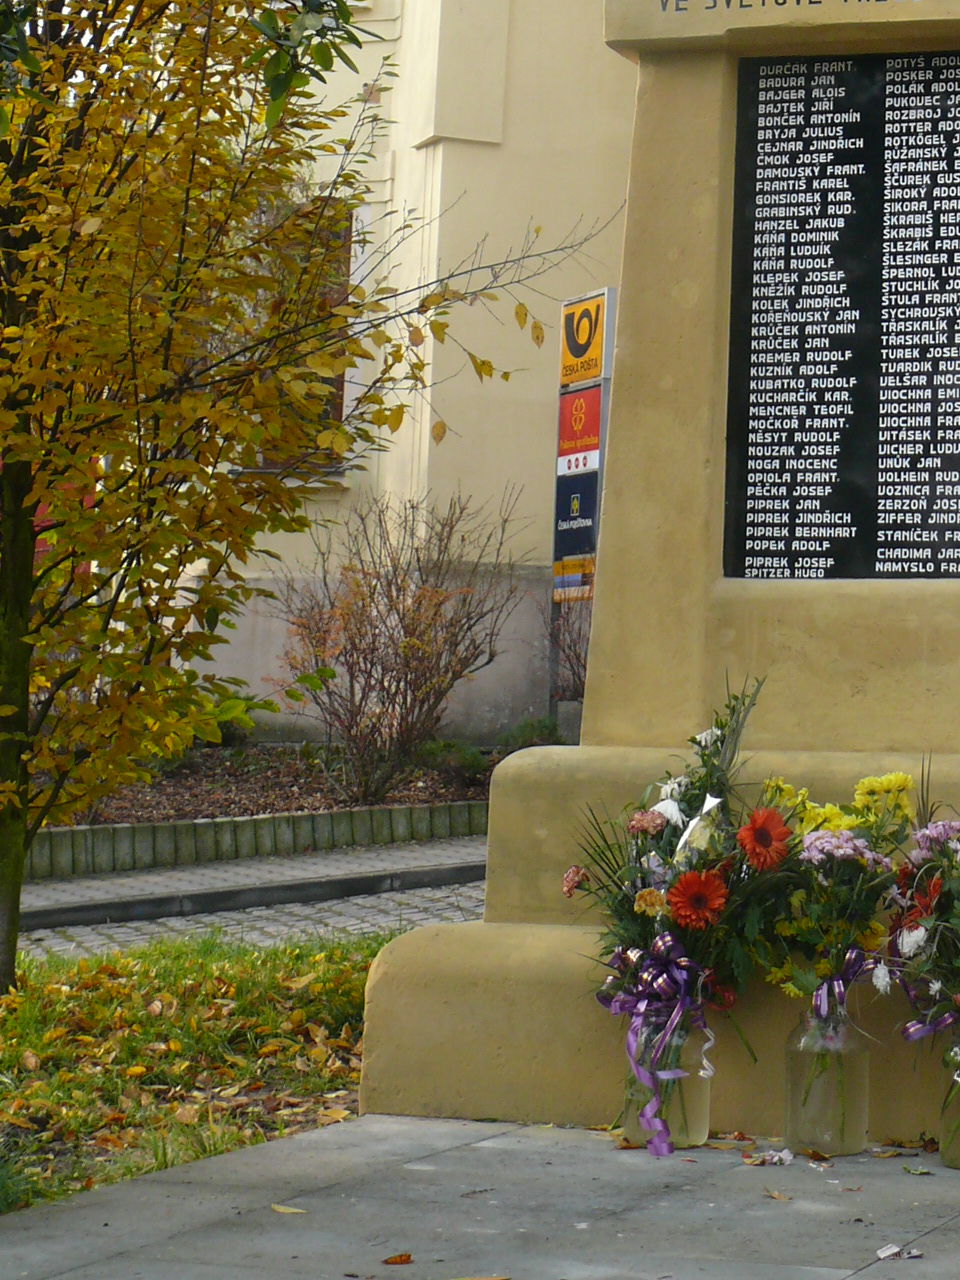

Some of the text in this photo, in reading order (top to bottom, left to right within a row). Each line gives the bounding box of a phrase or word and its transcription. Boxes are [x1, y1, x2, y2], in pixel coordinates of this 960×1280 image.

[885, 70, 932, 81] POSKER
[759, 75, 834, 88] BADURA JAN
[758, 87, 845, 100] BAJGER ALOIS
[758, 102, 804, 113] BAJTEK
[885, 108, 940, 120] ROZBROJ
[757, 126, 843, 139] BRYJA JULIUS
[885, 121, 931, 133] ROTTER
[757, 141, 803, 152] CEJNAR
[796, 152, 834, 163] JOSEF
[812, 178, 849, 189] KAREL
[755, 192, 821, 204] GONSIOREK
[883, 201, 927, 212] SIKORA
[754, 217, 844, 230] HANZEL JAKUB
[791, 231, 839, 242] DOMINIK
[790, 257, 834, 269] RUDOLF
[753, 270, 845, 283] KLEPEK JOSEF
[801, 284, 846, 294] RUDOLF
[752, 299, 788, 309] KOLEK
[836, 310, 859, 320] JAN
[804, 337, 828, 348] JAN
[750, 350, 852, 362] KREMER RUDOLF
[880, 348, 919, 358] TUREK
[799, 364, 838, 374] ADOLF
[750, 377, 856, 389] KUBATKO RUDOLF
[749, 404, 853, 415] MENCNER TEOFIL
[794, 431, 840, 442] RUDOLF
[801, 445, 840, 455] JOSEF
[748, 458, 837, 469] NOGA INOCENC
[917, 457, 940, 467] JAN
[748, 472, 790, 482] OPIOLA
[792, 486, 832, 495] JOSEF
[746, 499, 820, 509] PIPREK JAN
[746, 513, 788, 522] PIPREK
[877, 513, 921, 523] ZIFFER
[746, 526, 856, 536] PIPREK BERNHART
[746, 540, 830, 550] POPEK ADOLF
[877, 548, 931, 558] CHADIMA
[745, 557, 834, 567] PIPREK JOSEF
[875, 562, 934, 571] NAMYSLO
[745, 568, 824, 577] SPITZER HUGO
